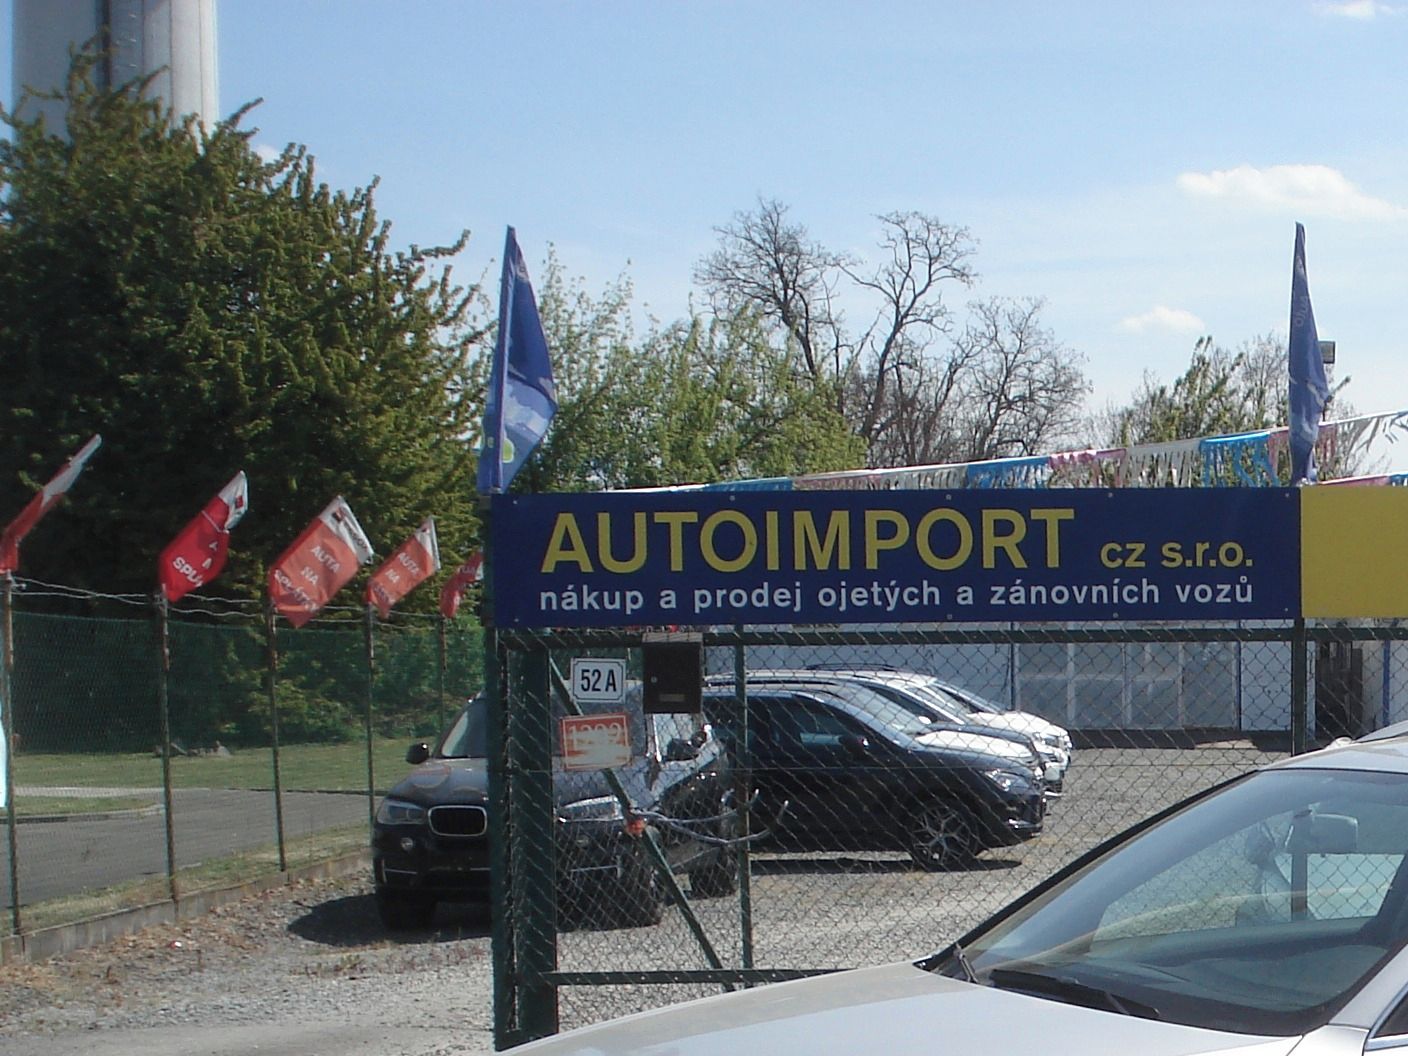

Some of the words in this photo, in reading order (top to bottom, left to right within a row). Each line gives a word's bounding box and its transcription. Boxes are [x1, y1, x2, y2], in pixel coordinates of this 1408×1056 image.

[541, 508, 1075, 573] AUTOIMPORT
[1101, 542, 1146, 568] cz
[1162, 541, 1253, 568] s.r.o.
[540, 584, 643, 614] nákup
[660, 589, 677, 609] a
[694, 582, 800, 613] prodej
[818, 580, 940, 611] ojetých
[957, 586, 974, 605] a
[990, 578, 1159, 605] zánovních
[1176, 576, 1252, 603] vozů
